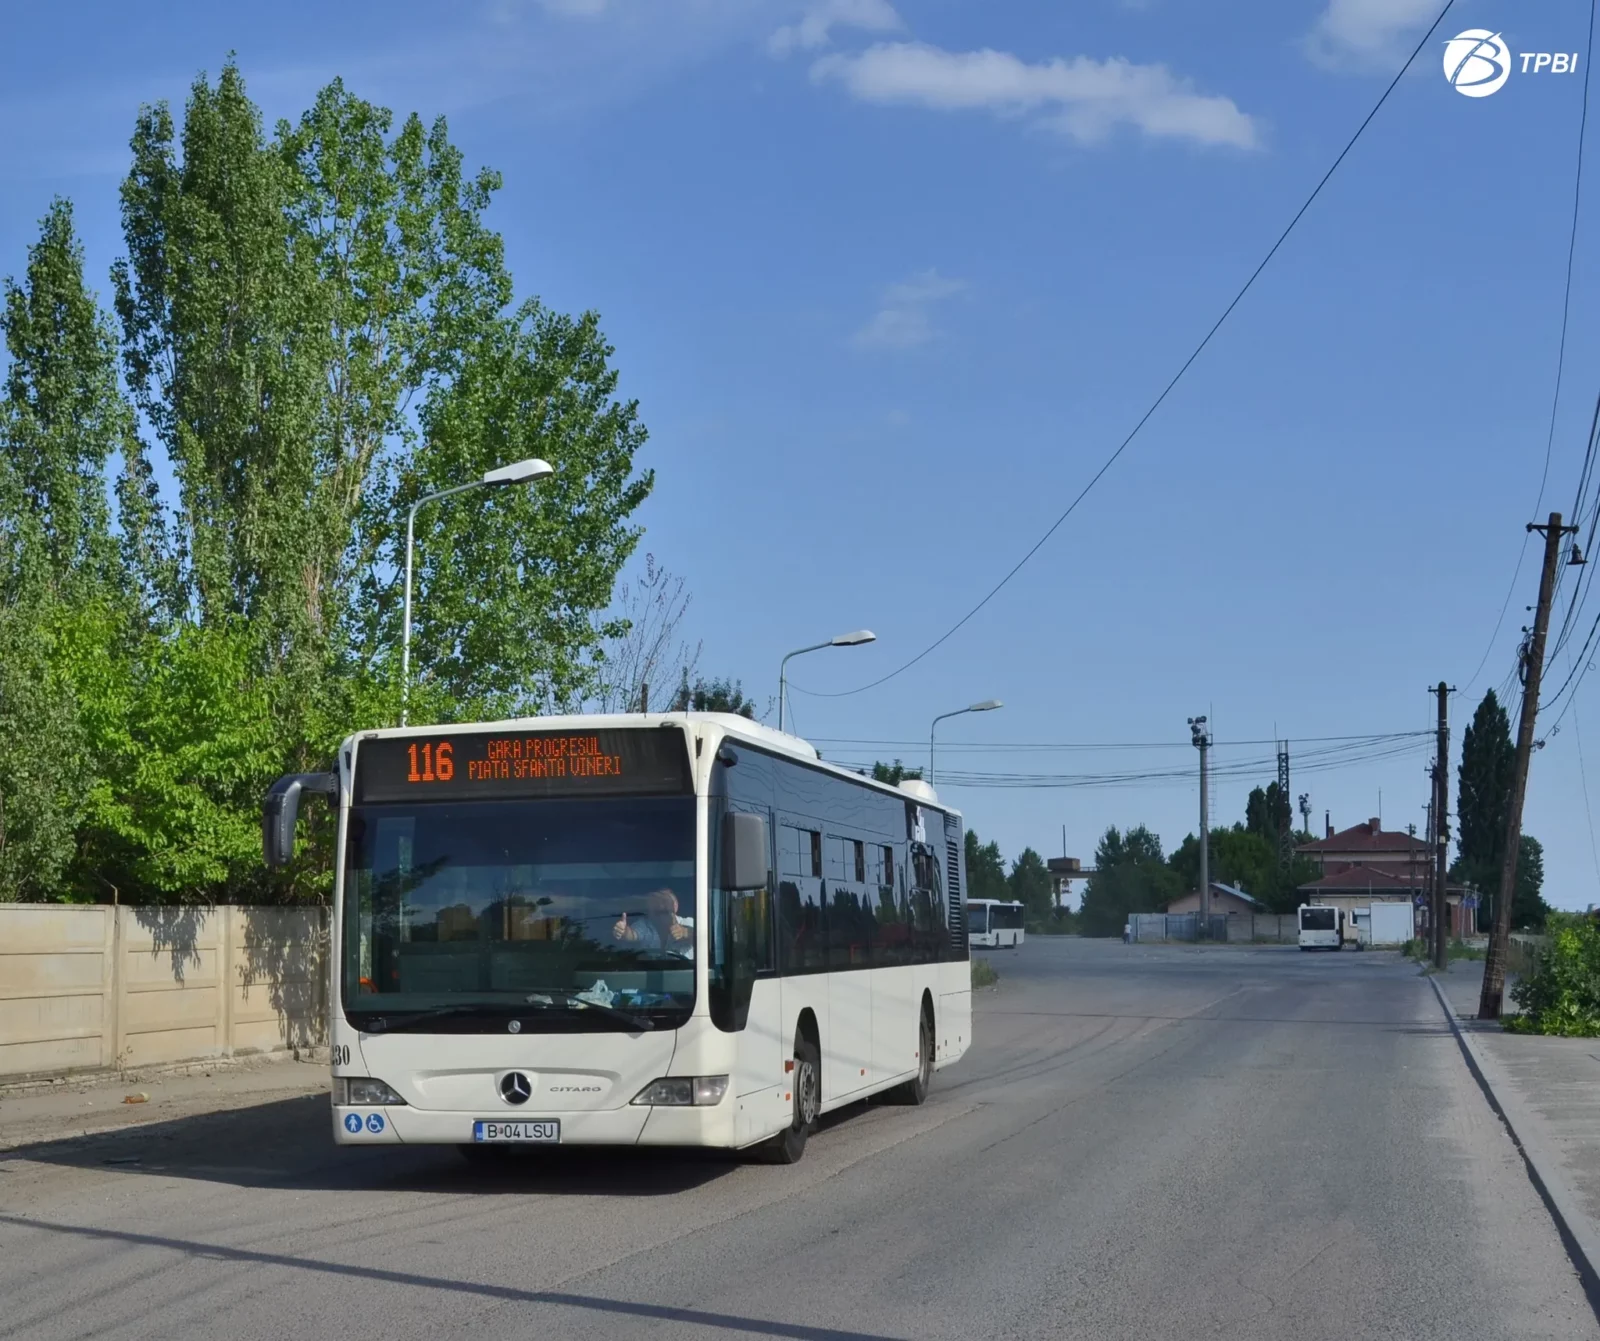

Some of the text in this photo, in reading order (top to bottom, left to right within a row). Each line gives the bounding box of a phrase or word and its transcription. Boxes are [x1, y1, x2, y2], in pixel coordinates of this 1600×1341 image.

[487, 737, 602, 759] GARA PROGRESUL
[407, 742, 454, 782] 116
[469, 756, 621, 780] PIATA SFANTA VINERI
